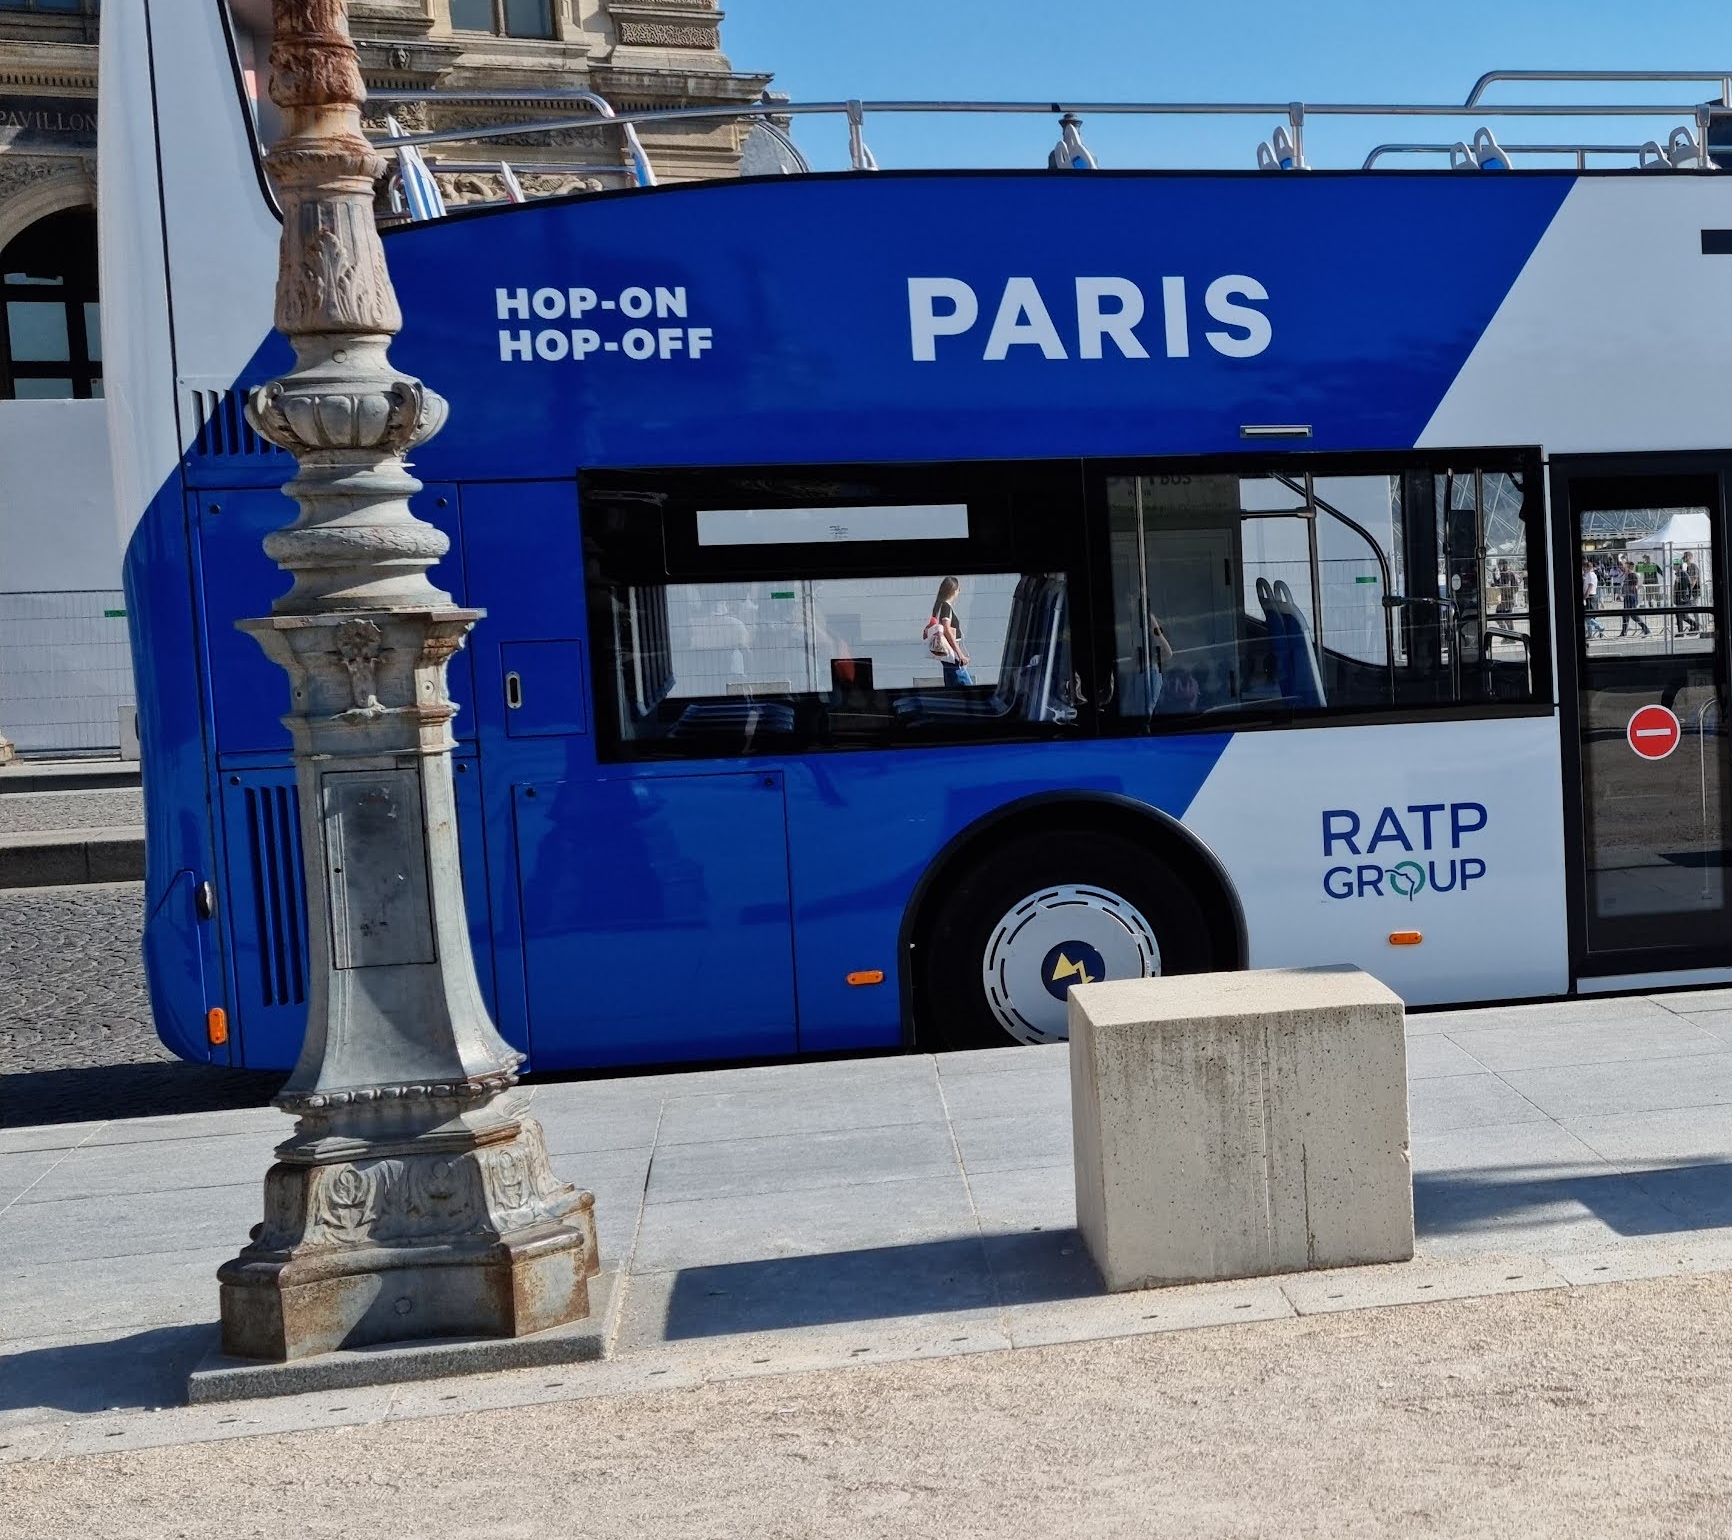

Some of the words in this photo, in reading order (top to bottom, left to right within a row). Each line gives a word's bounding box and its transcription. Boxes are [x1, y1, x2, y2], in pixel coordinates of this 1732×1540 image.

[0, 111, 98, 131] PAVILLON
[495, 286, 688, 319] HOP-ON
[908, 274, 1273, 361] PARIS
[499, 327, 712, 361] HOP-OFF
[1322, 802, 1488, 857] RATP
[1323, 858, 1487, 902] GROUP
